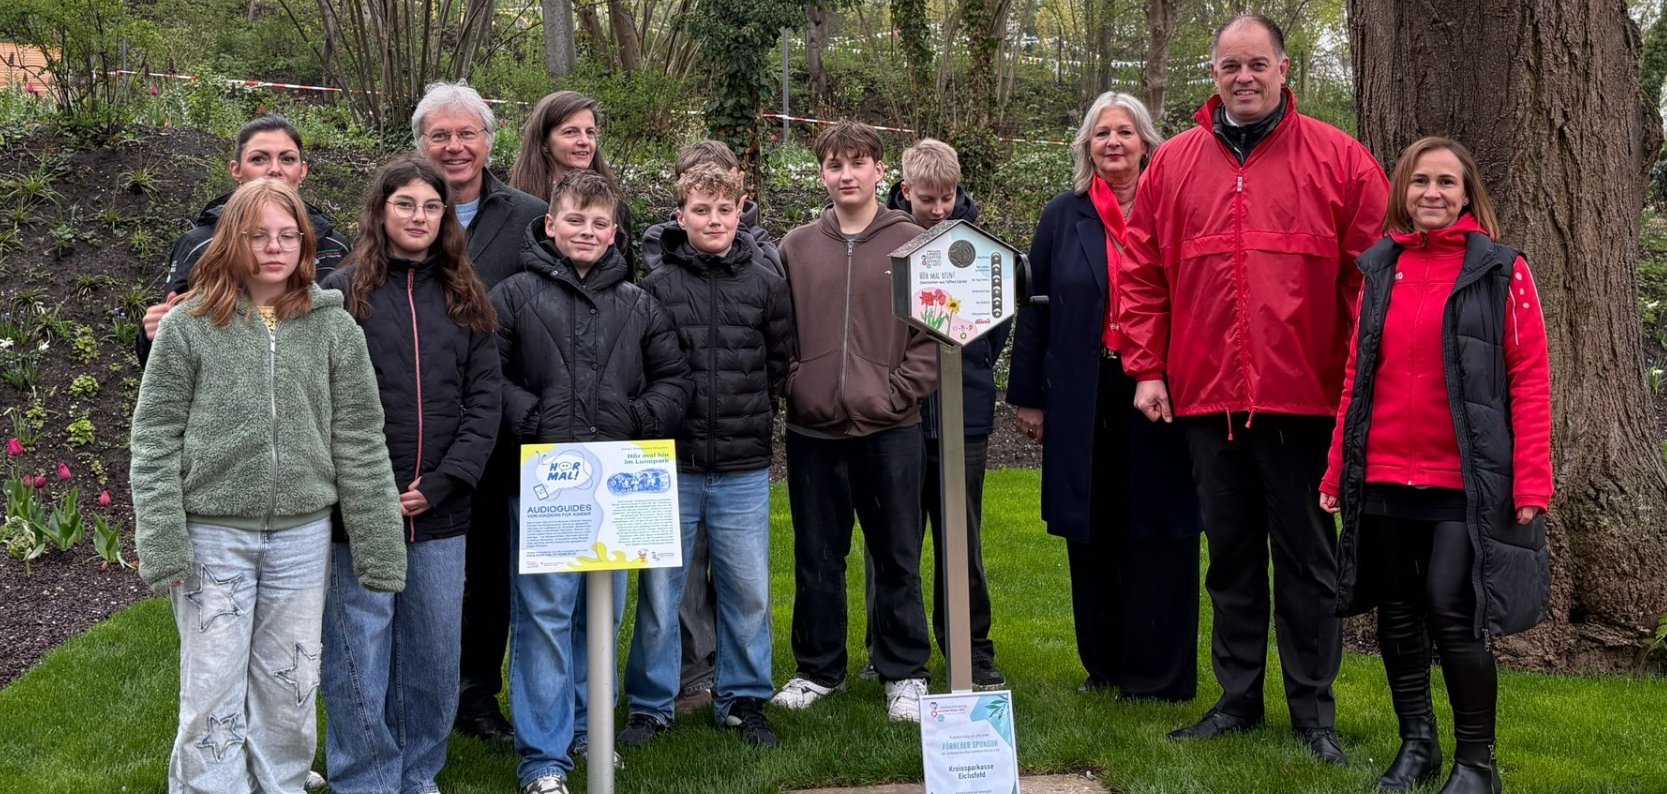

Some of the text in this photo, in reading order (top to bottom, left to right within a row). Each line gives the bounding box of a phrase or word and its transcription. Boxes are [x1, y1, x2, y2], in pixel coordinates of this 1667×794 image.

[547, 470, 579, 481] MAL!
[527, 504, 592, 514] AUDIOGUIDES
[948, 764, 994, 772] Kreissparkasse
[958, 771, 986, 780] Eichsfeld
